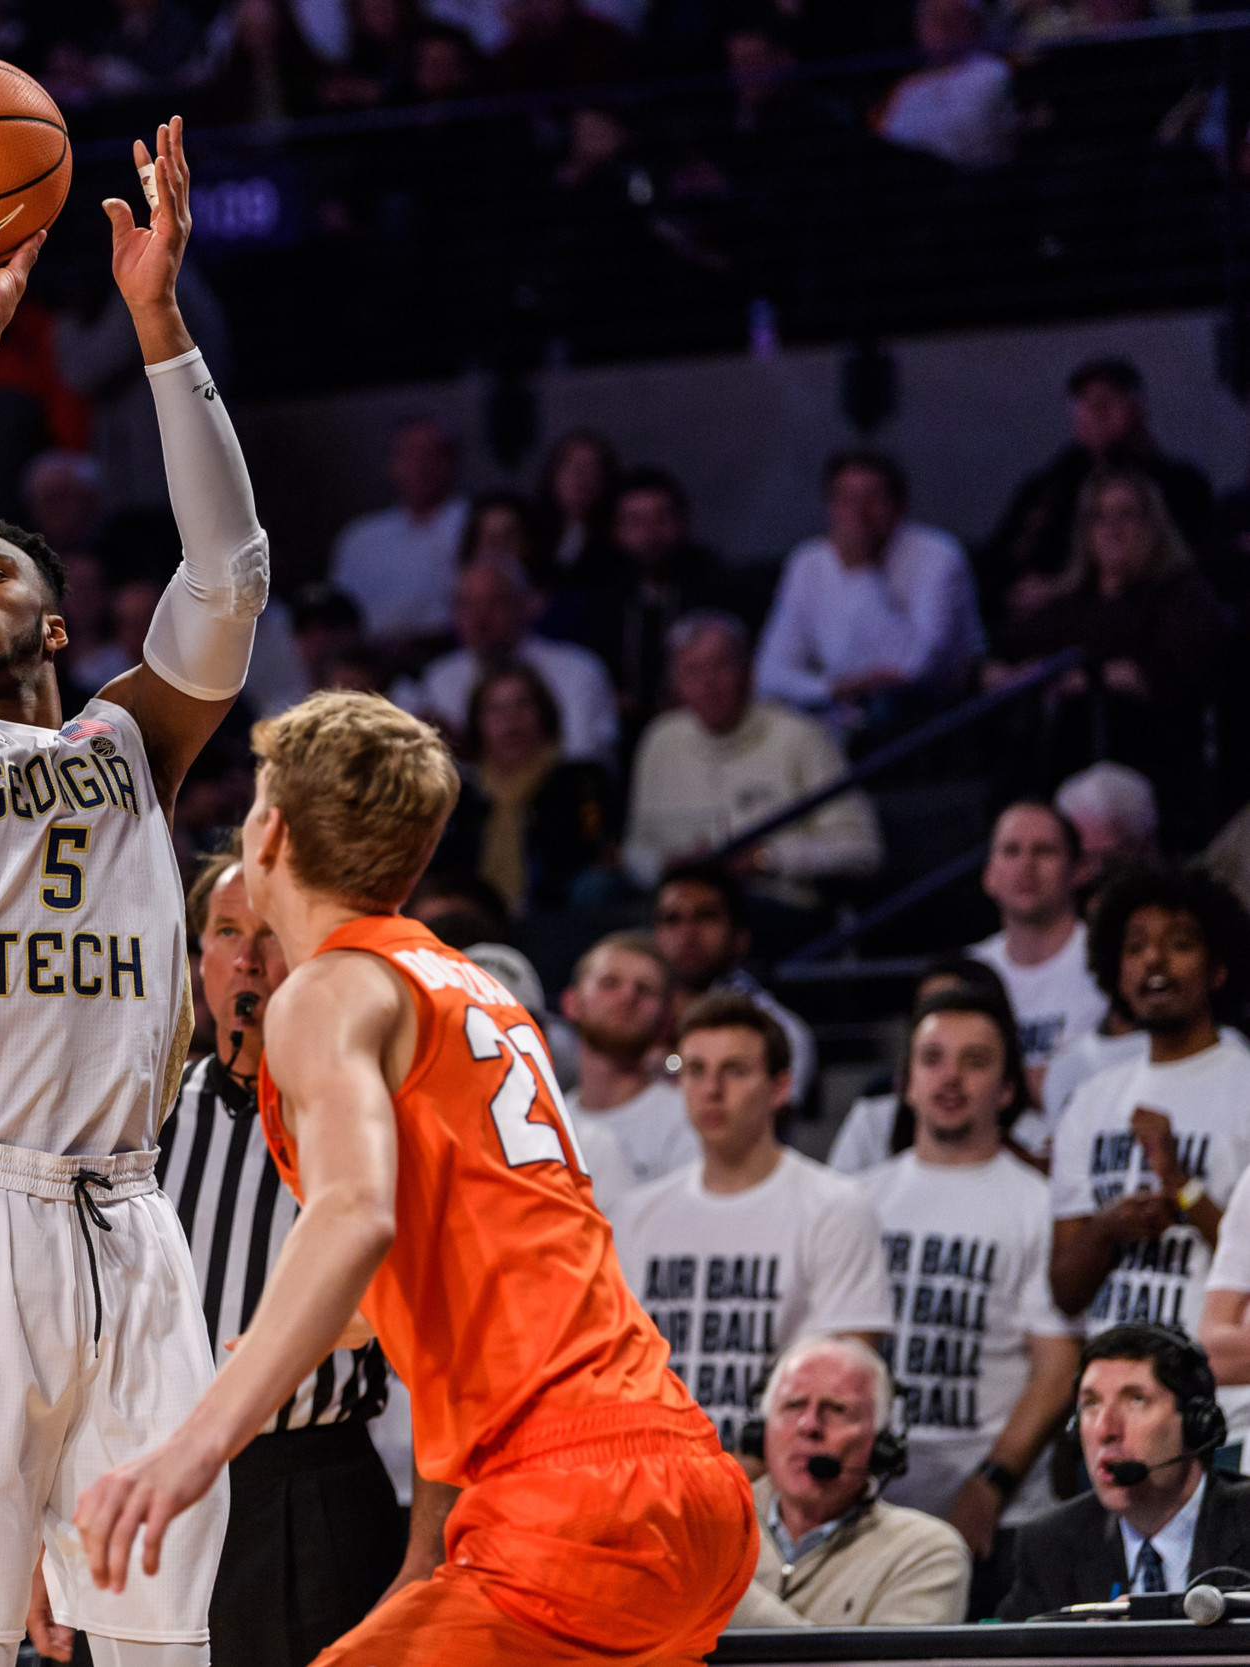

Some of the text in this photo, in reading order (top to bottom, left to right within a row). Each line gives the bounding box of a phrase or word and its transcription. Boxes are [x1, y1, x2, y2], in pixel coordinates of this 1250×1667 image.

[39, 824, 91, 913] 5
[463, 1004, 591, 1178] 21
[645, 1257, 780, 1301] AIR BALL
[921, 1234, 996, 1285] BALL
[702, 1309, 776, 1355] BALL
[913, 1284, 986, 1333] BALL
[907, 1334, 980, 1379] BALL
